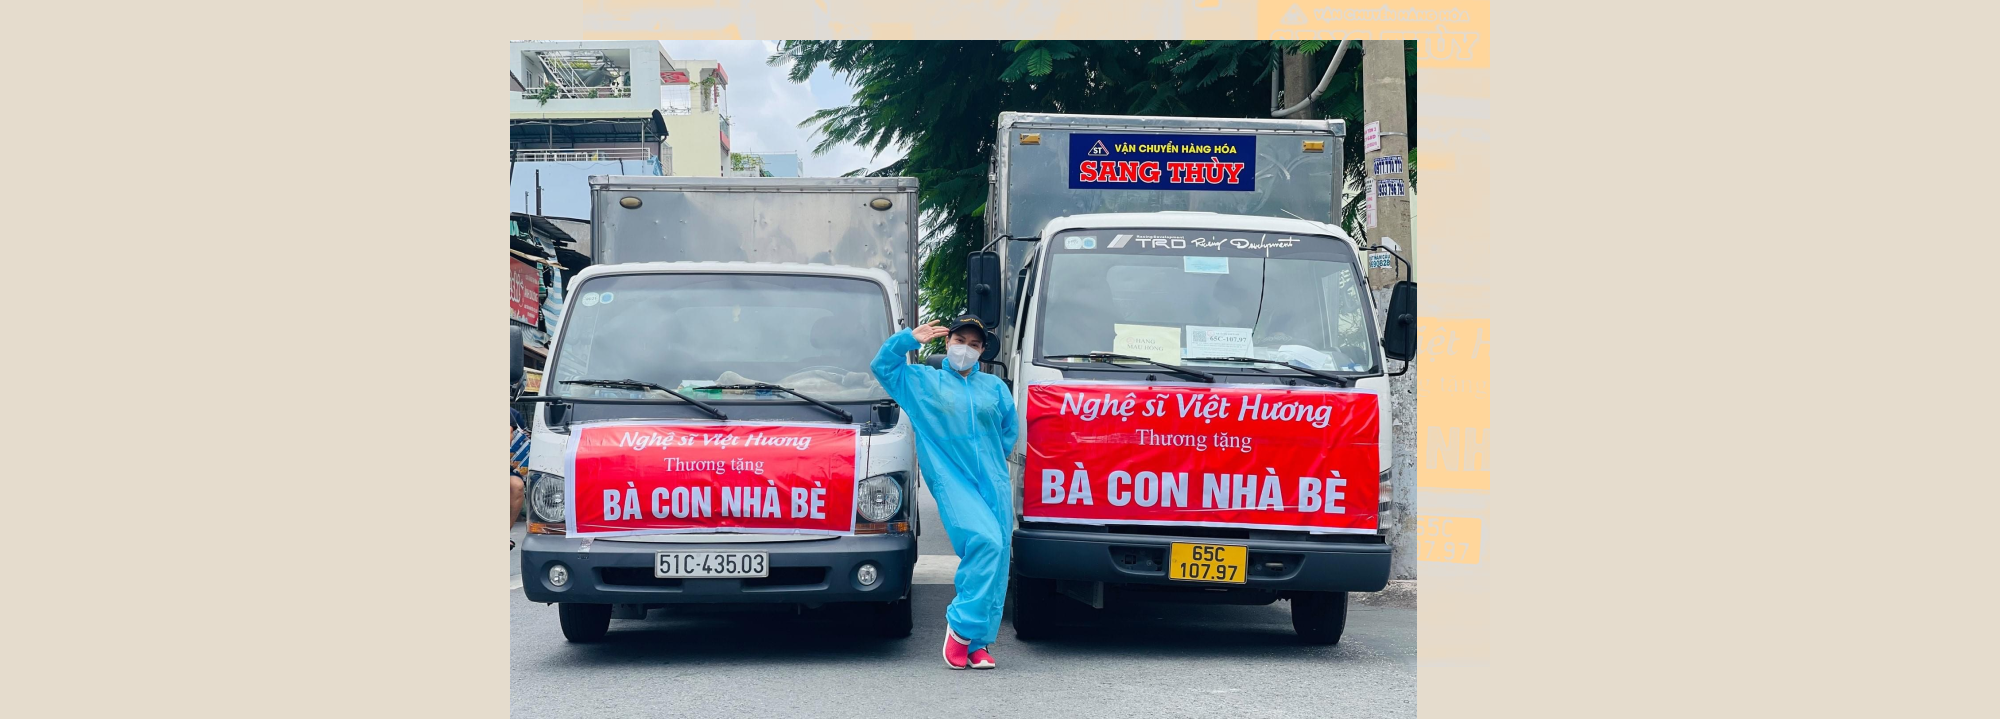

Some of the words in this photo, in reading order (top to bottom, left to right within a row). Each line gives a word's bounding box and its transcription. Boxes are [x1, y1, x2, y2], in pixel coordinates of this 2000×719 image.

[1114, 142, 1136, 155] VẬN
[1138, 141, 1178, 154] CHUYỂN
[1181, 143, 1212, 154] HÀNG
[1214, 143, 1237, 154] HÓA
[1079, 160, 1162, 183] SANG
[1166, 156, 1245, 184] THÙY
[1135, 238, 1187, 249] TRD
[1060, 392, 1138, 423] Nghệ
[1142, 394, 1165, 418] sĩ
[1176, 394, 1231, 424] Việt
[1237, 395, 1333, 428] Hương
[619, 431, 675, 451] Nghệ
[677, 432, 696, 447] sĩ
[703, 433, 741, 450] Việt
[744, 433, 812, 450] Hương
[1136, 428, 1208, 452] Thương
[1212, 432, 1252, 453] tặng
[664, 457, 726, 475] Thương
[730, 457, 765, 475] tặng
[1041, 462, 1094, 507] BÀ
[1107, 470, 1189, 508] CON
[1202, 467, 1285, 512] NHÀ
[1298, 470, 1347, 514] BÈ
[603, 481, 643, 521] BÀ
[651, 487, 712, 519] CON
[721, 479, 782, 519] NHÀ
[790, 480, 827, 520] BÈ
[1192, 545, 1226, 562] 65C
[660, 554, 764, 574] 51C-435.03
[1180, 562, 1238, 580] 107.97
